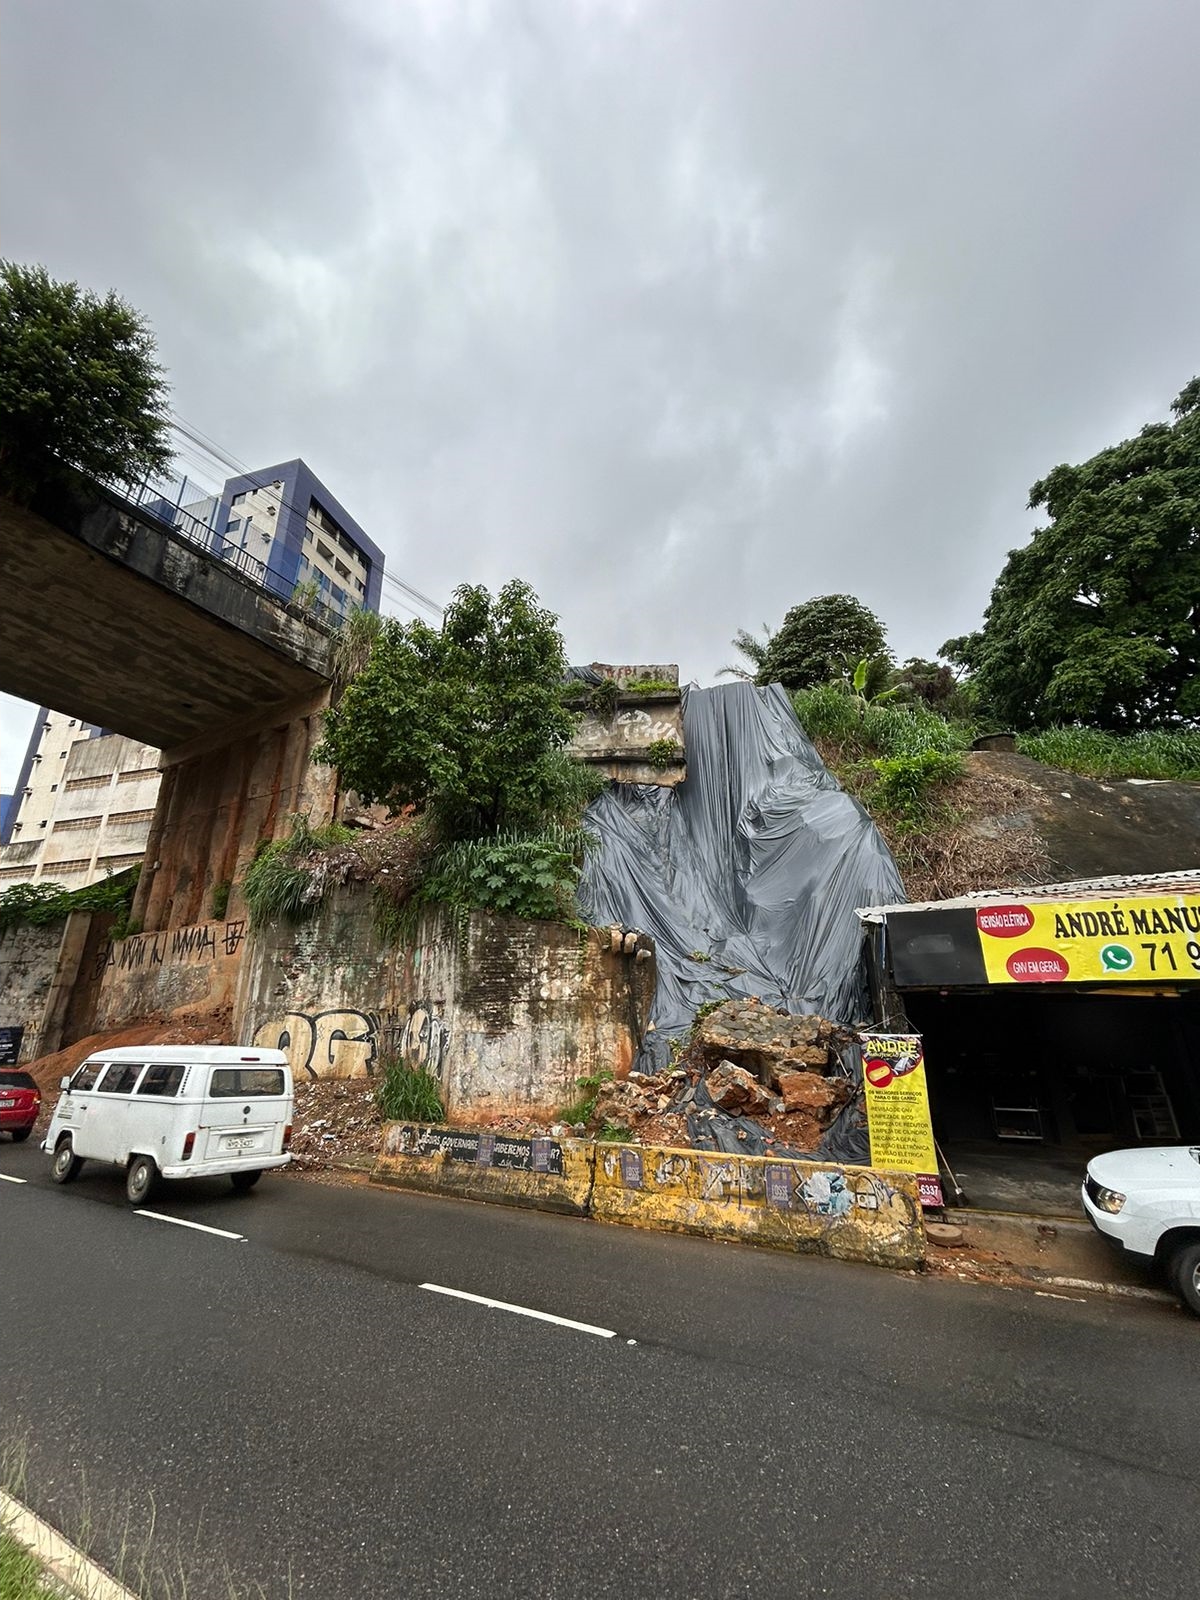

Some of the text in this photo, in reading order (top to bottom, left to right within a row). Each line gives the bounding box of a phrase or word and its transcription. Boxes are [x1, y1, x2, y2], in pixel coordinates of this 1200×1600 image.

[981, 911, 1030, 928] REVISÃO ELÉTRICA
[1055, 903, 1200, 938] ANDRÉ MANU
[1013, 960, 1063, 974] GNV EM GERAL
[1141, 942, 1177, 971] 71
